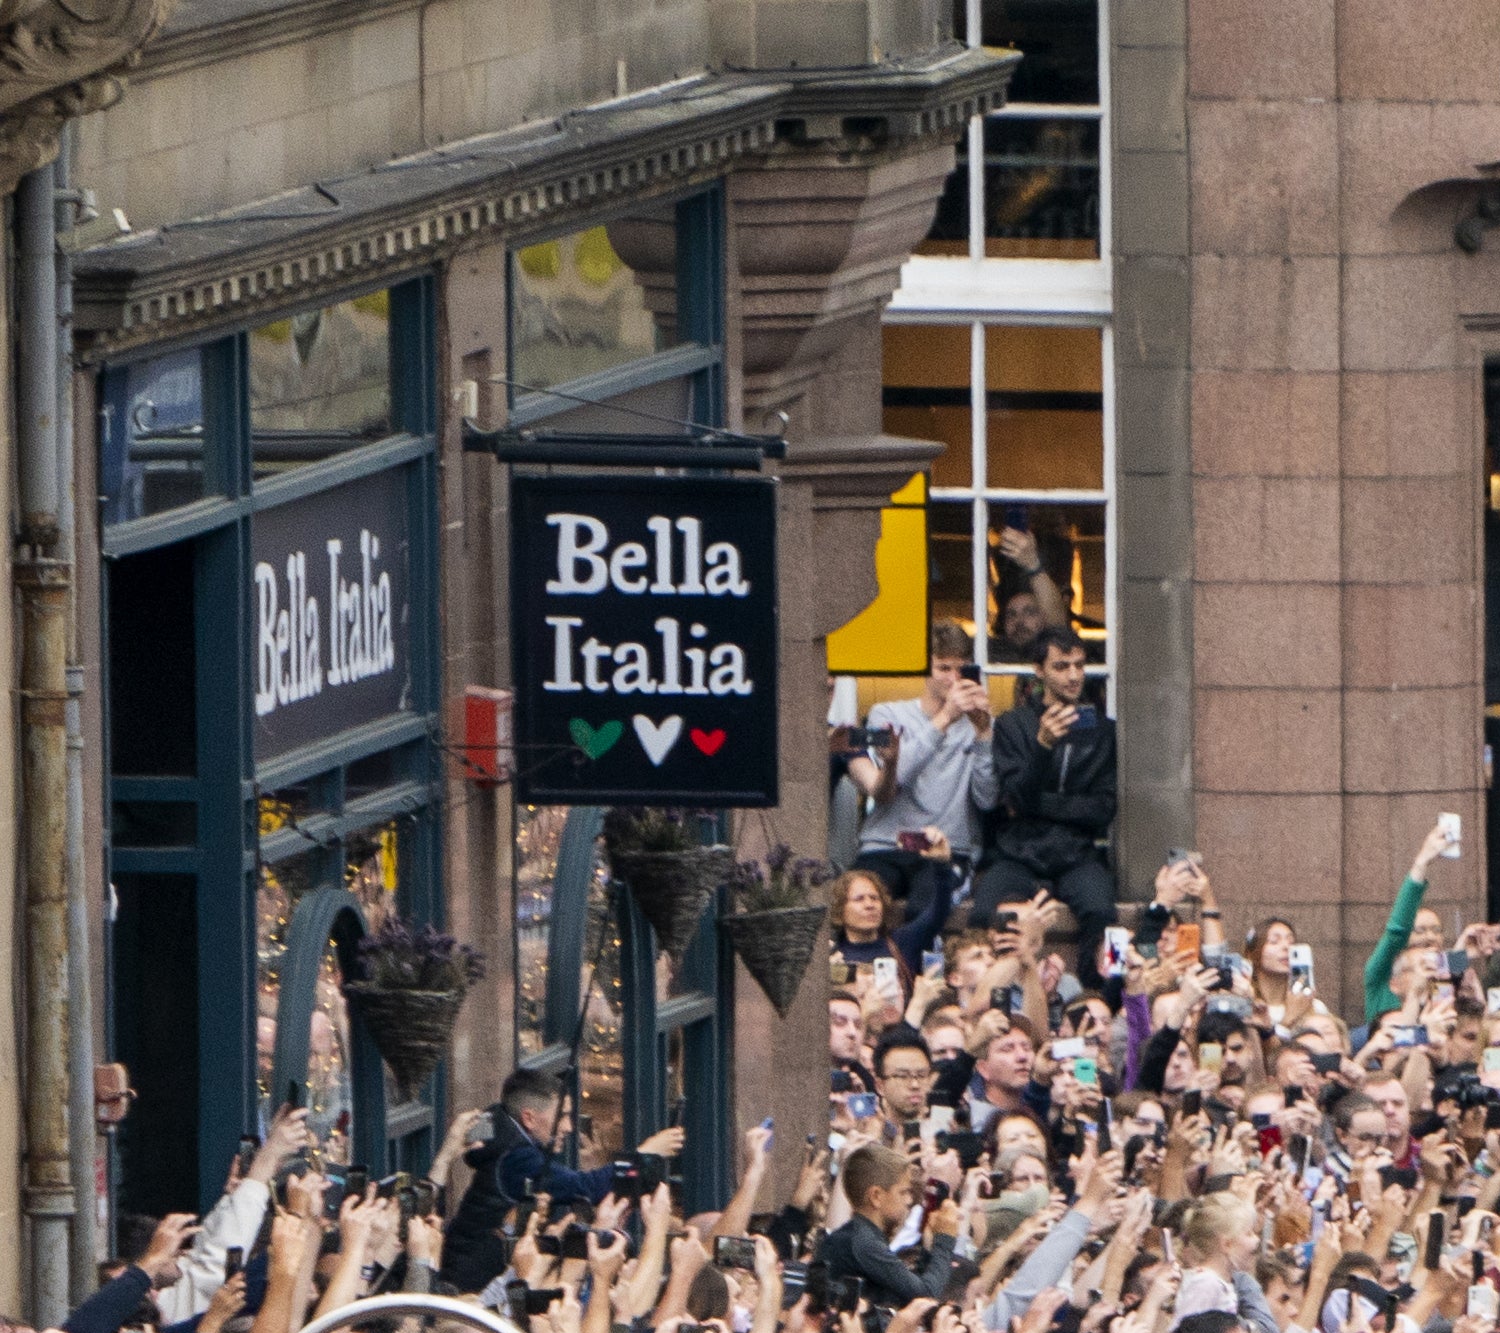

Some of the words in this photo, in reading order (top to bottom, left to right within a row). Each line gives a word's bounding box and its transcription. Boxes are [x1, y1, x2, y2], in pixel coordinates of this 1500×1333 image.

[546, 513, 750, 597] Bella
[254, 550, 322, 717] Bella
[327, 529, 395, 686] Italia
[543, 616, 753, 695] Italia
